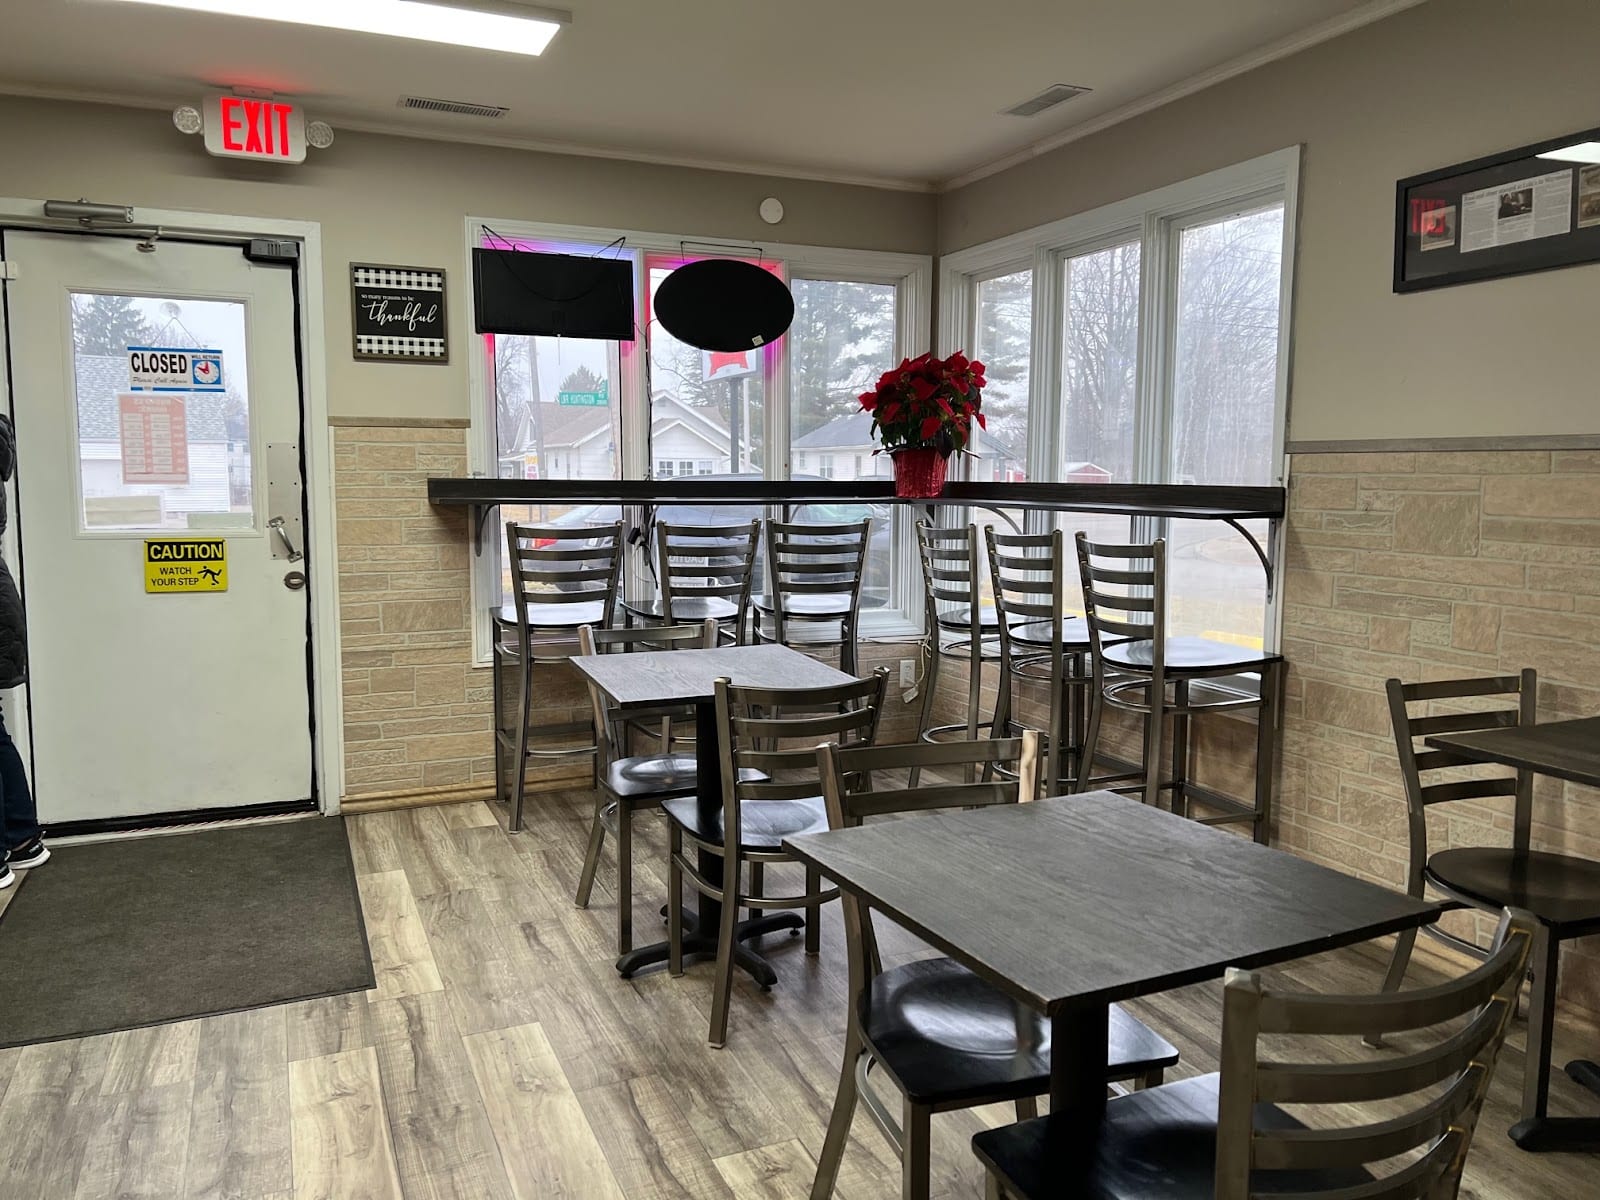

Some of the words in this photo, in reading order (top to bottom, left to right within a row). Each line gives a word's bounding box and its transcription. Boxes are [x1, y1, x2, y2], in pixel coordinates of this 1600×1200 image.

[221, 96, 292, 156] EXIT
[361, 300, 437, 332] thankful
[131, 352, 187, 374] CLOSED
[150, 543, 223, 560] CAUTION
[160, 567, 192, 575] WATCH
[151, 578, 176, 586] YOUR
[178, 577, 199, 586] STEP
